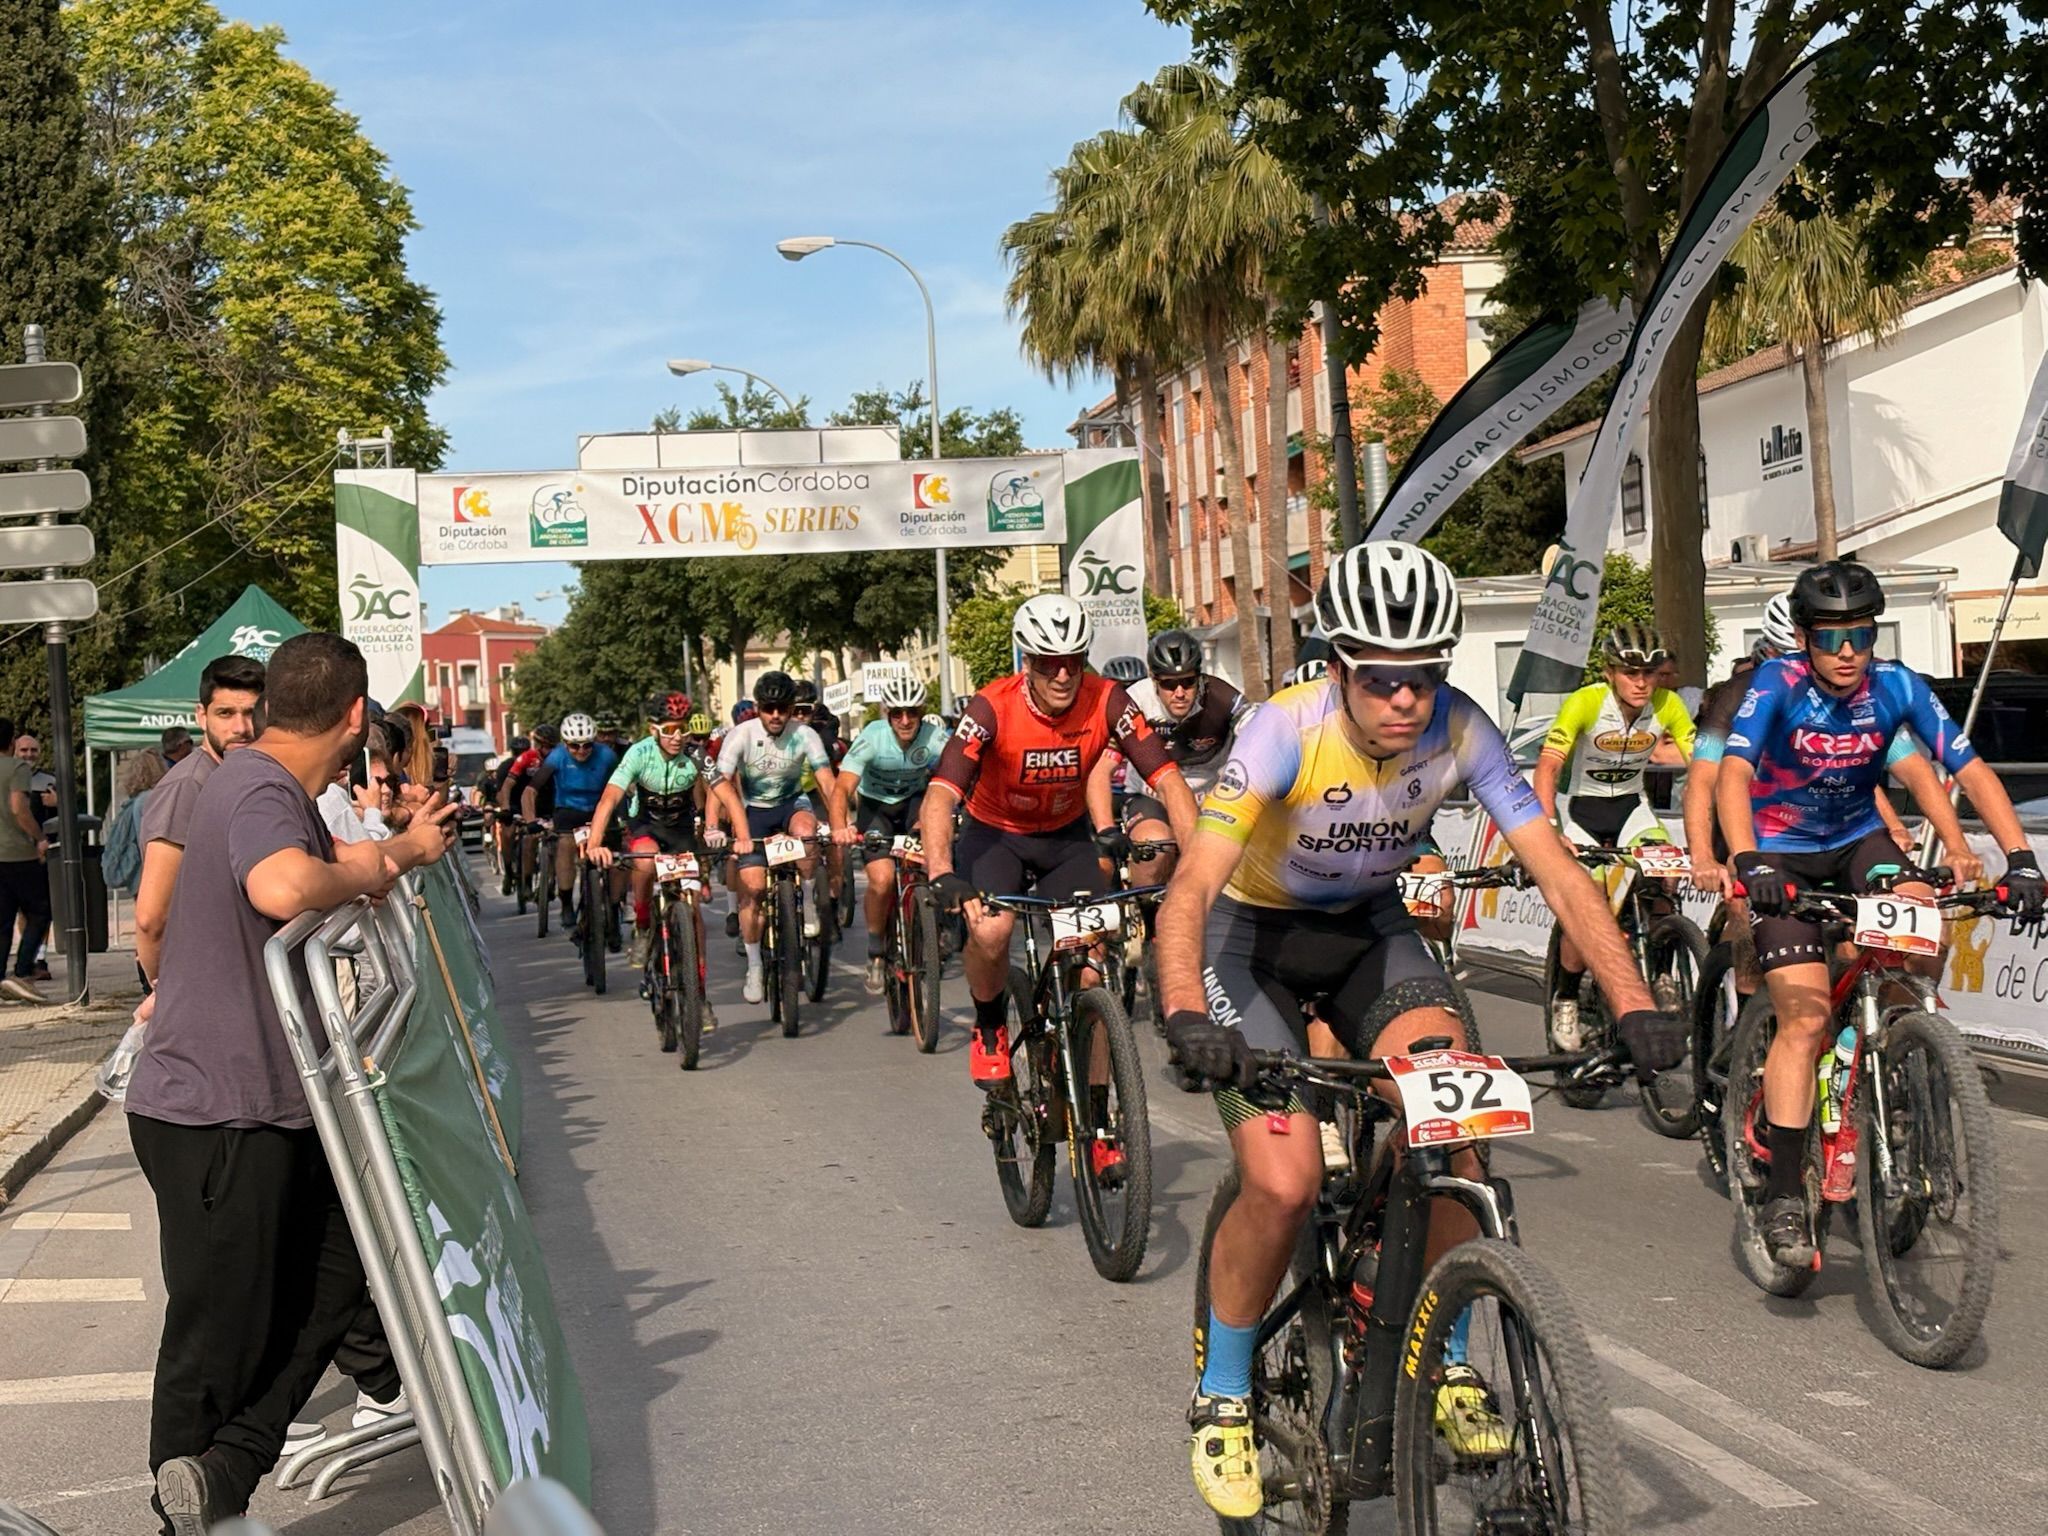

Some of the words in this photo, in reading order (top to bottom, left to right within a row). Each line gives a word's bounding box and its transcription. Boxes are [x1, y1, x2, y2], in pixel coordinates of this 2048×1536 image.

[1391, 321, 1635, 541] ANDALUCIACICLISMO.COM
[635, 502, 737, 545] XCM
[764, 505, 861, 533] SERIES
[900, 511, 966, 524] Diputación
[439, 526, 507, 539] Diputación
[900, 526, 915, 537] de
[918, 524, 967, 535] Córdoba
[439, 540, 455, 551] de
[458, 539, 508, 551] Córdoba
[1084, 599, 1139, 608] EDERACIÓN
[1087, 608, 1140, 617] NDALUZA
[1092, 618, 1141, 627] CLISMO
[1536, 607, 1581, 631] DALUZA
[349, 624, 413, 634] FEDERACIÓN
[350, 634, 413, 643] ANDALUZA
[363, 644, 414, 653] CLISMO
[867, 667, 906, 680] PARRILLA
[139, 713, 201, 727] ANDAL
[1794, 728, 1880, 755] KREA
[1025, 749, 1079, 768] BIKE
[1328, 818, 1409, 839] UNIÓN
[773, 839, 795, 854] 70
[1069, 907, 1106, 933] 13
[1501, 897, 1516, 924] de
[1876, 901, 1918, 934] 91
[1995, 954, 2026, 1000] de
[1203, 966, 1243, 1028] UNION
[1428, 1070, 1503, 1114] 52
[1404, 1290, 1438, 1380] MAXXIS
[1193, 1328, 1205, 1372] XIS
